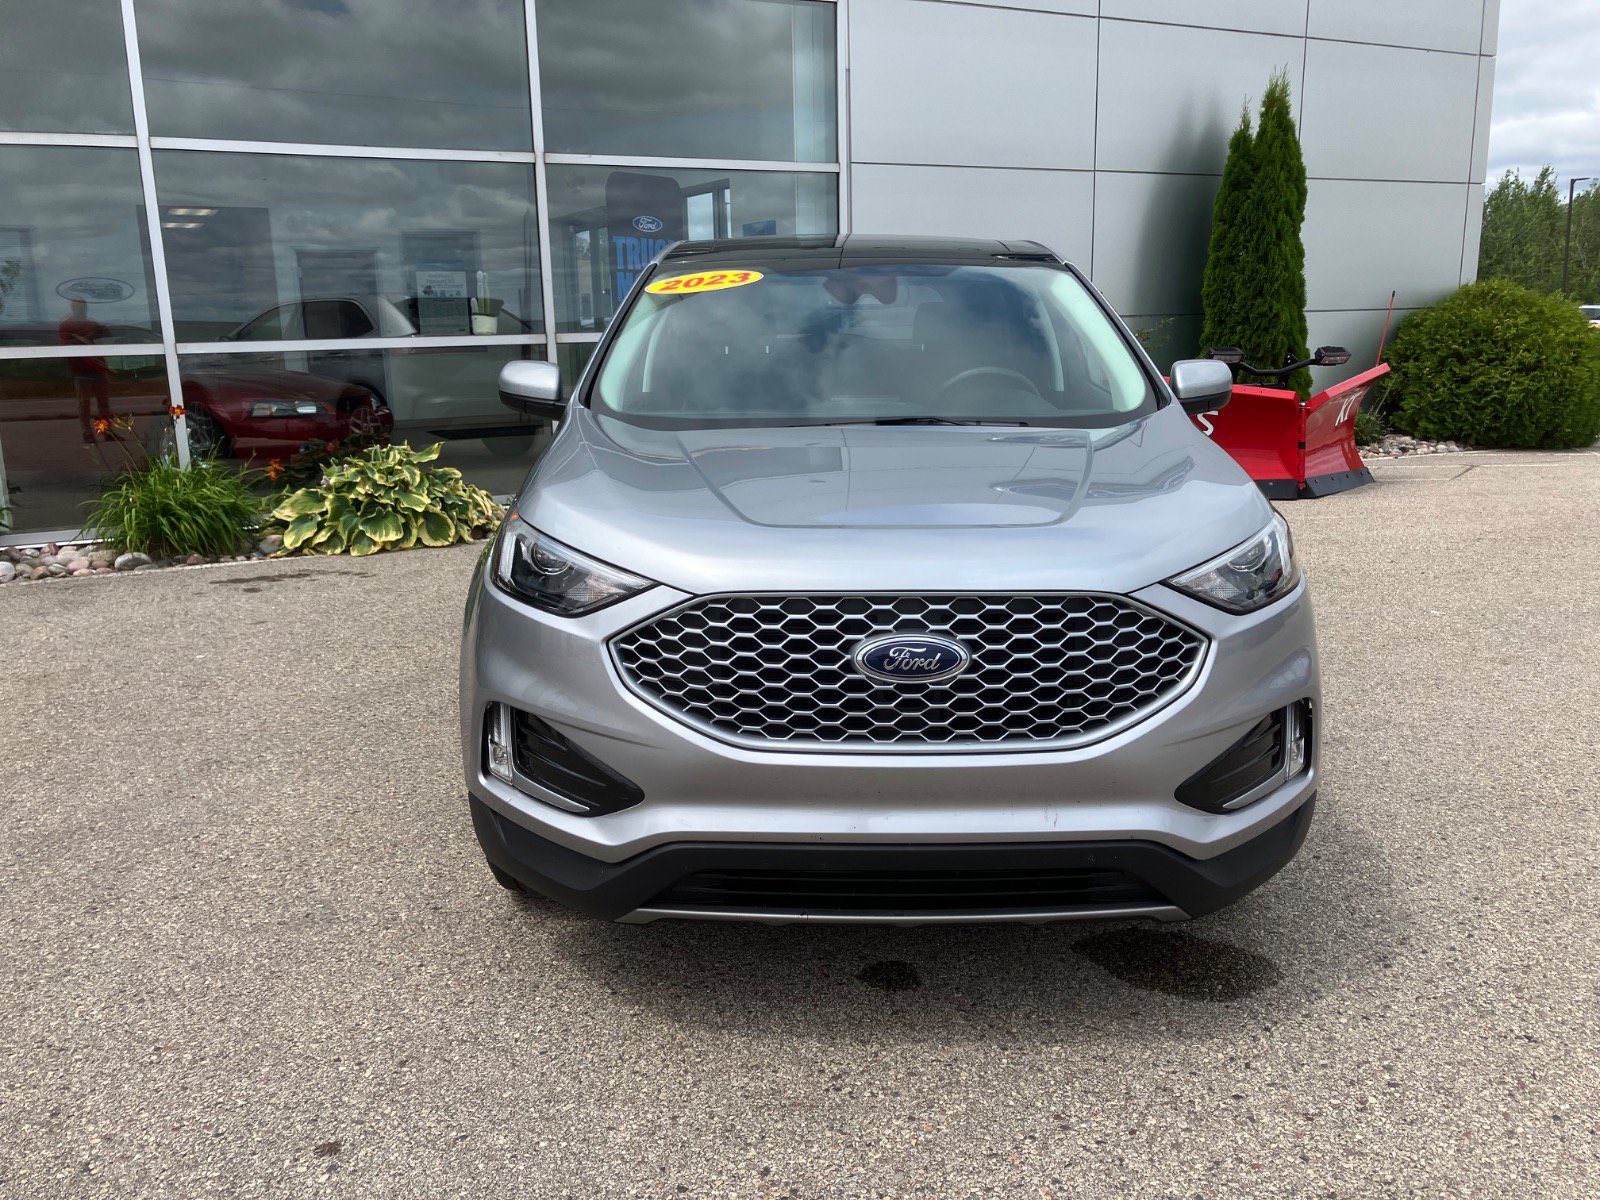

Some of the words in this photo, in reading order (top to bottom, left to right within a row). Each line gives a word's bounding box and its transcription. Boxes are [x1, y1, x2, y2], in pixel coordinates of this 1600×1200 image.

[638, 217, 658, 230] Ford
[612, 235, 676, 270] TRUC
[659, 272, 751, 291] 2023
[883, 646, 941, 671] Ford
